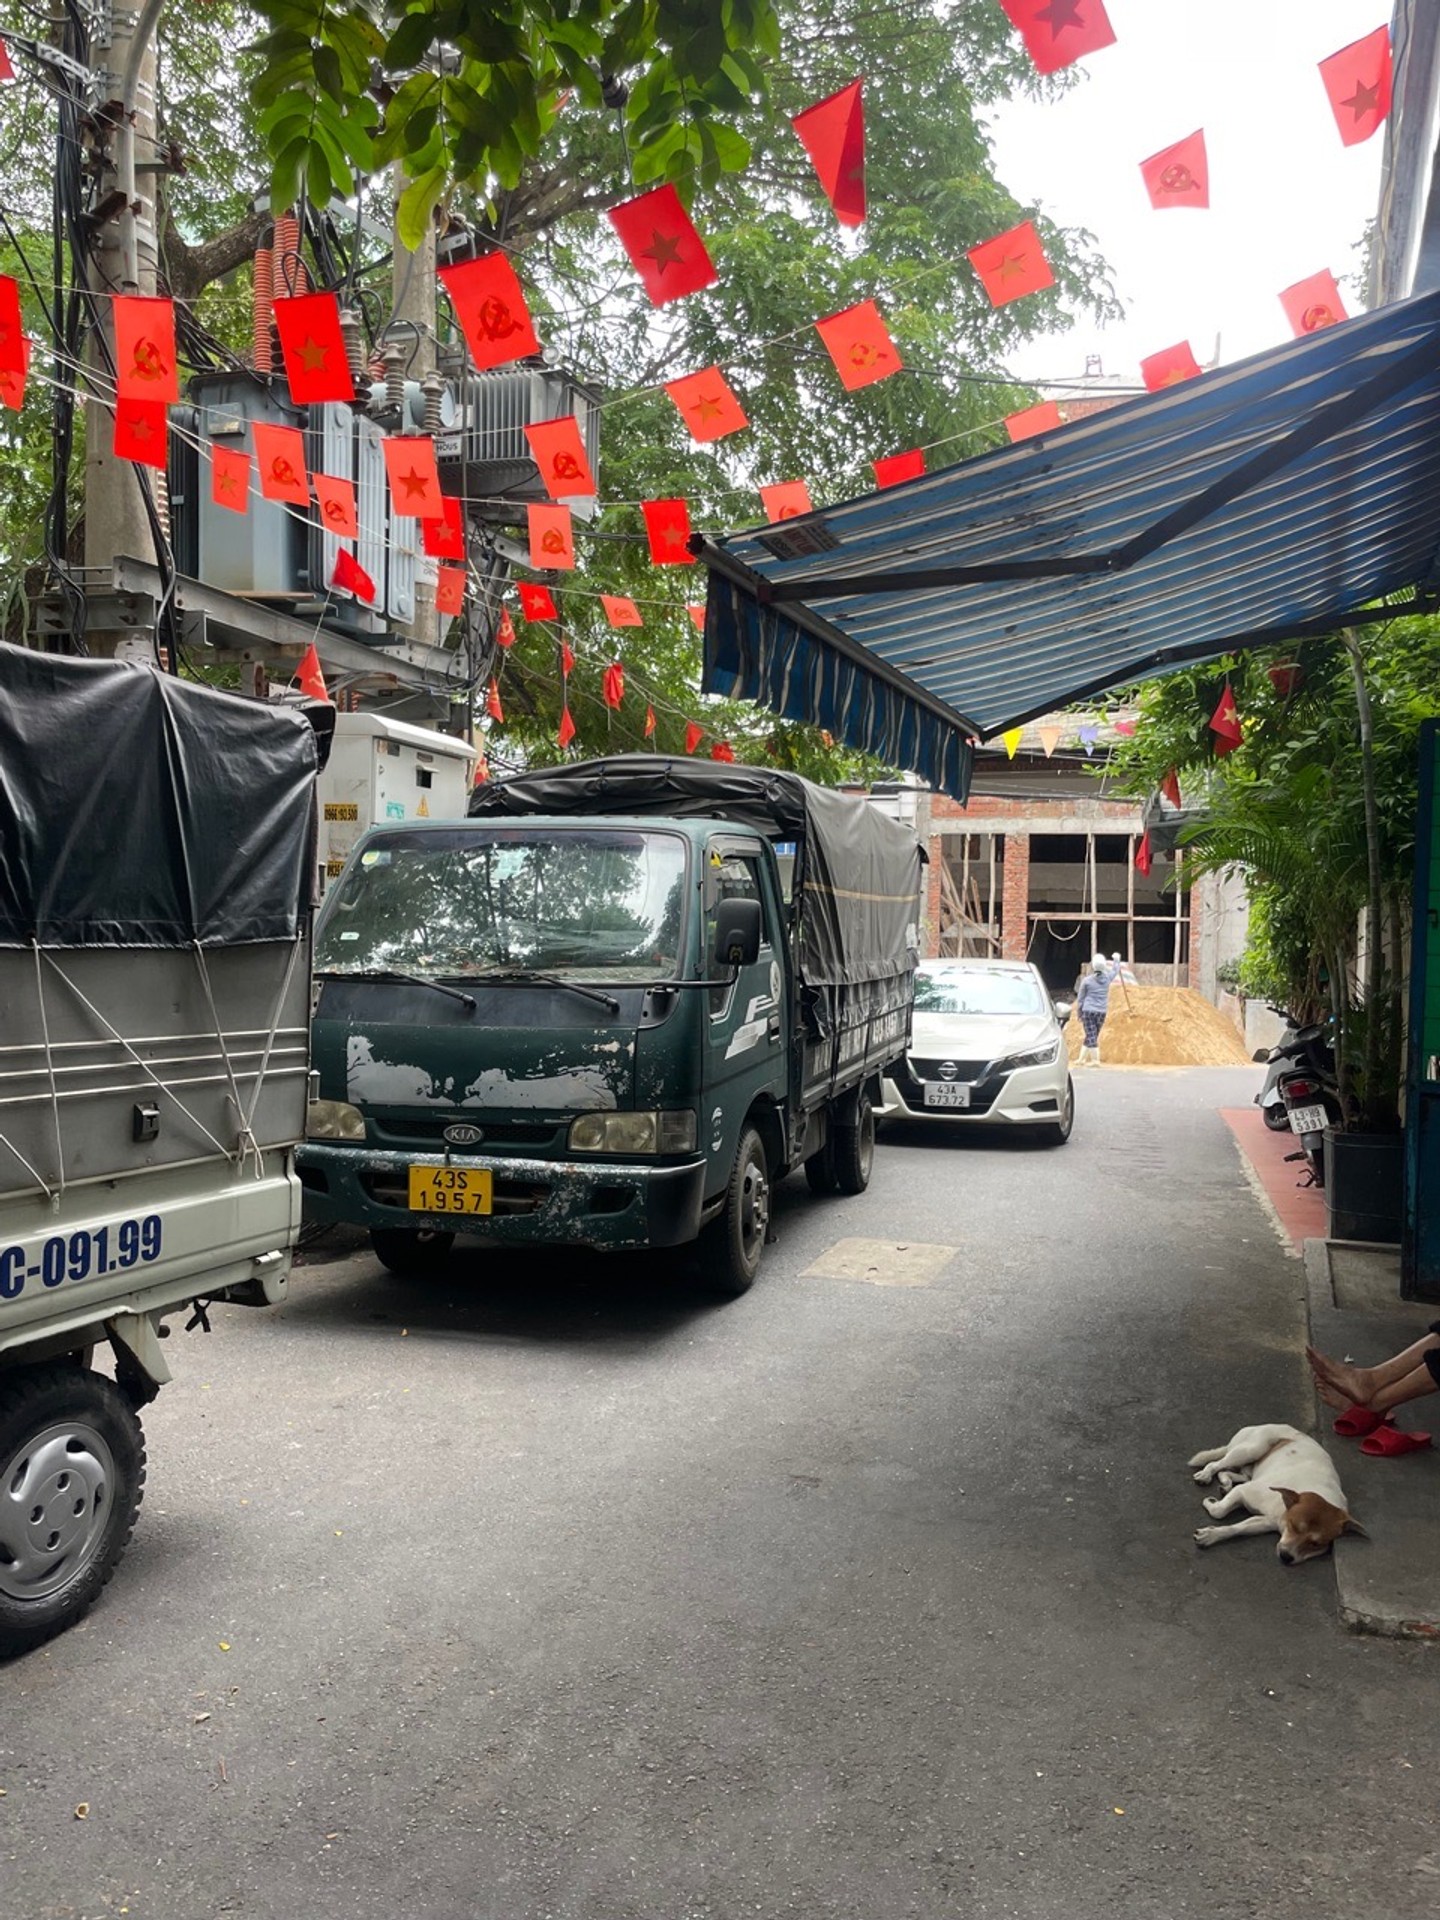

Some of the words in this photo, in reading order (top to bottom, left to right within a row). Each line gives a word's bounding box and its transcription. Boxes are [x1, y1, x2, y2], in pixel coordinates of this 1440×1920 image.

[936, 1085, 957, 1095] 43A
[928, 1094, 965, 1106] 673.72
[449, 1127, 478, 1143] KIA
[432, 1170, 468, 1189] 43S
[0, 1214, 163, 1299] C-091.99
